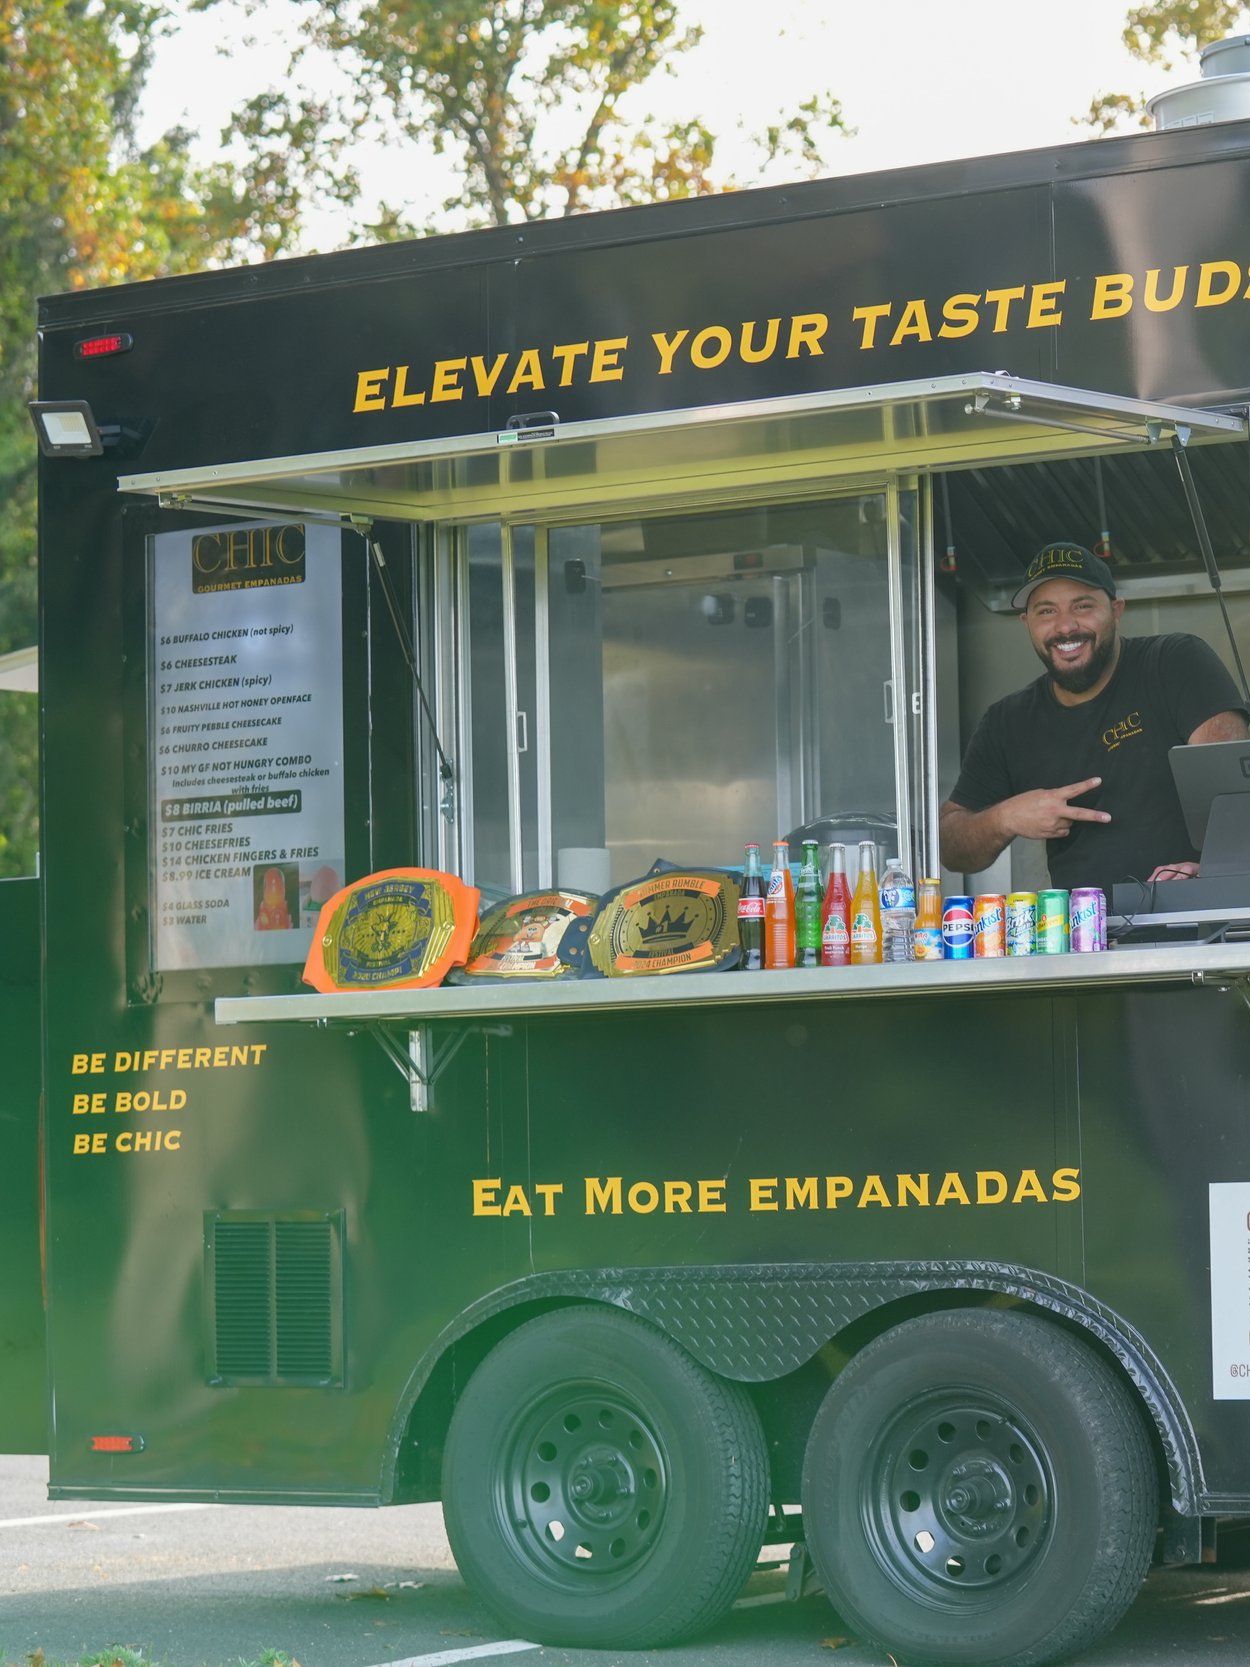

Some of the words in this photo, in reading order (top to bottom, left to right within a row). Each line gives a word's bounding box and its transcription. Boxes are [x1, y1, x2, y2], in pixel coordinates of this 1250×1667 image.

[354, 337, 627, 412] ELEVATE
[652, 314, 828, 374] YOUR
[853, 281, 1066, 349] TASTE
[193, 524, 305, 573] CHIC
[197, 581, 242, 593] GOURMET
[244, 576, 302, 589] EMPANADAS
[160, 636, 171, 646] $6
[173, 632, 210, 644] BUFFALO
[212, 628, 249, 640] CHICKEN
[250, 627, 268, 638] (not
[269, 624, 294, 636] spicy)
[160, 661, 172, 671] $6
[174, 654, 238, 670] CHEESESTEAK
[160, 684, 172, 694] $7
[174, 681, 197, 692] JERK
[199, 678, 240, 690] CHICKEN
[241, 674, 272, 688] (spicy)
[160, 705, 176, 715] $10
[178, 702, 221, 713] NASHVILLE
[222, 700, 240, 710] HOT
[241, 698, 269, 708] HONEY
[270, 694, 312, 705] OPENFACE
[172, 723, 200, 734] FRUITY
[201, 721, 230, 732] PEBBLE
[231, 717, 282, 729] CHEESECAKE
[172, 742, 210, 754] CHURRO
[212, 737, 268, 750] CHEESECAKE
[161, 766, 179, 776] $10
[181, 764, 197, 774] MY
[198, 763, 211, 773] GF
[212, 761, 232, 772] NOT
[233, 757, 274, 770] HUNGRY
[275, 755, 312, 767] COMBO
[172, 777, 206, 788] Includes
[207, 773, 256, 785] cheesesteak
[268, 769, 298, 781] buffalo
[298, 768, 330, 778] chicken
[231, 784, 250, 795] with
[251, 783, 270, 793] fries
[165, 804, 180, 817] $8
[182, 801, 222, 815] BIRRIA
[223, 796, 265, 815] (pulled
[266, 794, 298, 810] beef)
[161, 827, 175, 838] $7
[177, 825, 203, 837] CHIC
[205, 823, 233, 834] FRIES
[162, 842, 182, 853] $10
[184, 837, 251, 851] CHEESEFRIES
[185, 853, 231, 866] CHICKEN
[233, 849, 277, 862] FINGERS
[279, 849, 287, 859] &
[290, 847, 319, 859] FRIES
[195, 869, 212, 880] ICE
[213, 867, 252, 879] CREAM
[672, 879, 705, 889] RUMBLE
[176, 901, 203, 911] GLASS
[205, 899, 230, 909] SODA
[176, 915, 207, 925] WATER
[651, 953, 692, 968] CHAMPION
[72, 1054, 106, 1073] BE
[115, 1045, 266, 1072] DIFFERENT
[73, 1094, 106, 1114] BE
[116, 1090, 187, 1112] BOLD
[74, 1134, 107, 1153] BE
[116, 1130, 181, 1152] CHIC
[473, 1179, 562, 1216] EAT
[585, 1177, 726, 1214] MORE
[750, 1168, 1080, 1210] EMPANADAS
